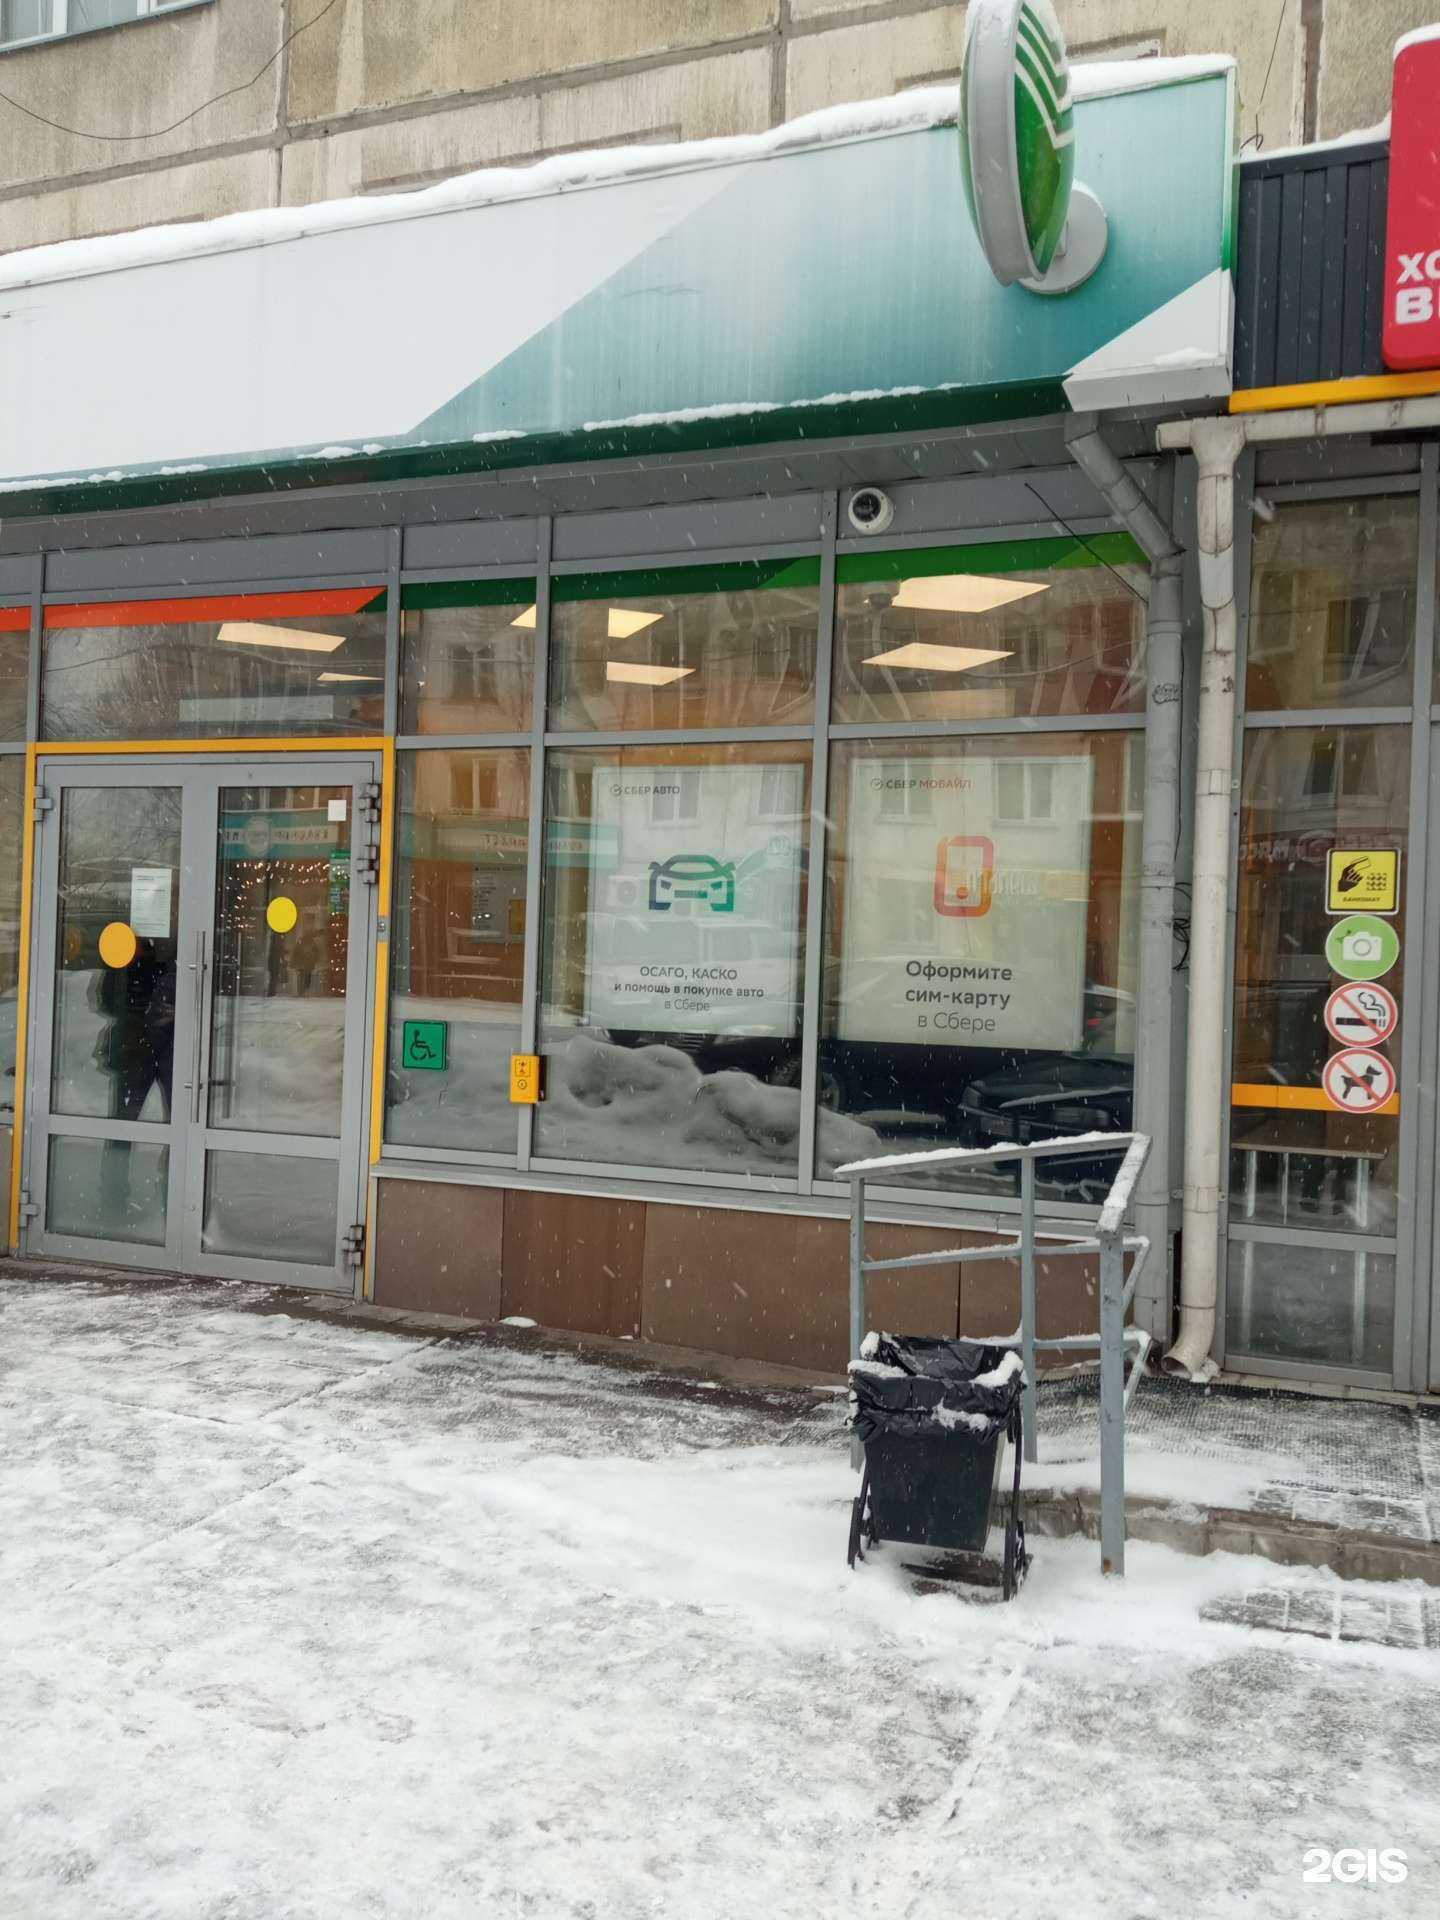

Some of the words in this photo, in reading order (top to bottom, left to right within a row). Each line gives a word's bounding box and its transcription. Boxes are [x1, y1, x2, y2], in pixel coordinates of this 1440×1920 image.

[1395, 286, 1440, 325] В
[640, 966, 688, 980] ОСАГО,
[692, 968, 738, 980] КАСКО
[906, 960, 1013, 982] Оформите
[614, 983, 622, 992] и
[624, 984, 671, 994] помощь
[674, 985, 681, 994] в
[683, 986, 734, 997] покупке
[736, 988, 765, 998] авто
[905, 989, 1011, 1010] сим-карту
[664, 1000, 671, 1009] в
[674, 999, 711, 1012] Сбере
[918, 1015, 928, 1028] в
[933, 1011, 996, 1034] Сбере
